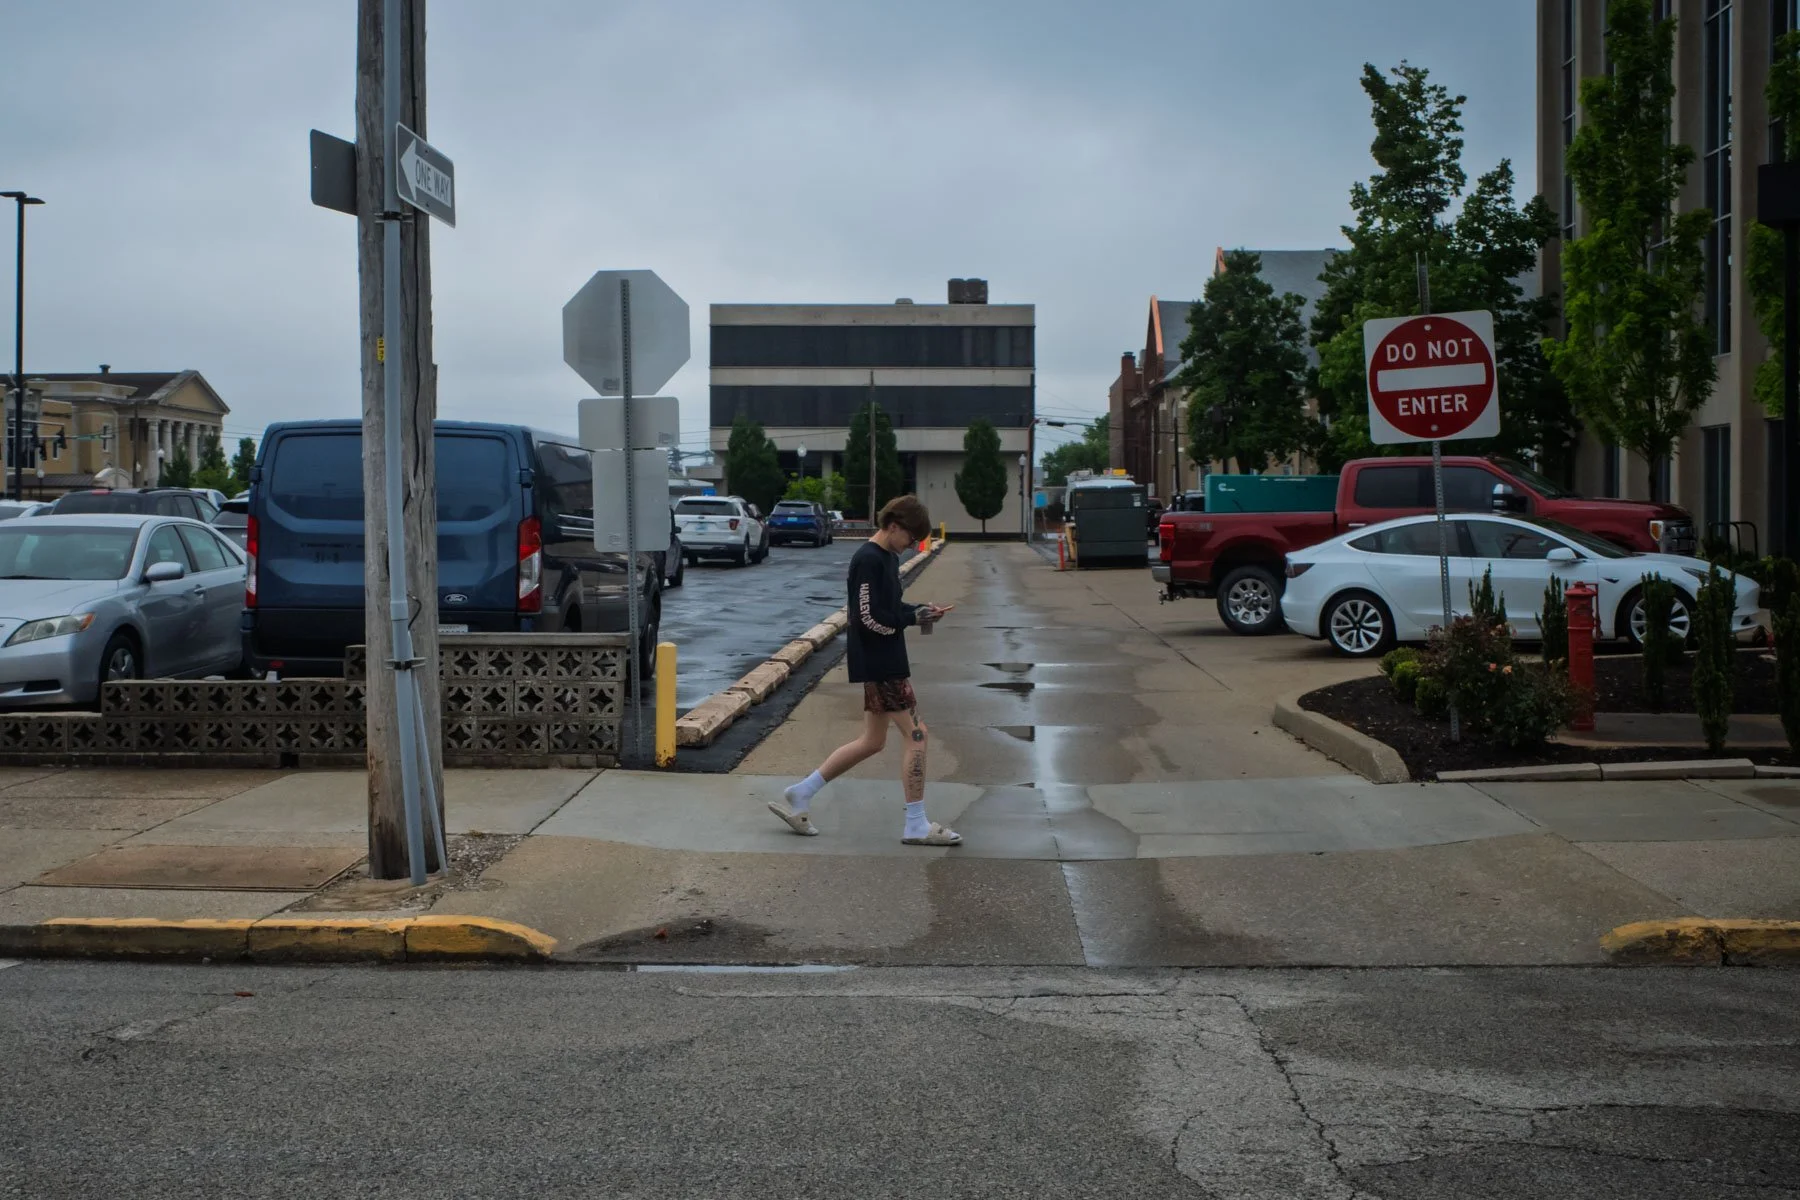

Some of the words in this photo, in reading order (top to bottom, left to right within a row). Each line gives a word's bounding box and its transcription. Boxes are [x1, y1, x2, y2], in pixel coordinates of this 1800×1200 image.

[415, 159, 432, 192] ONE
[434, 169, 450, 203] WAY
[1386, 342, 1416, 363] DO
[1427, 338, 1473, 359] NOT
[1398, 393, 1468, 416] ENTER
